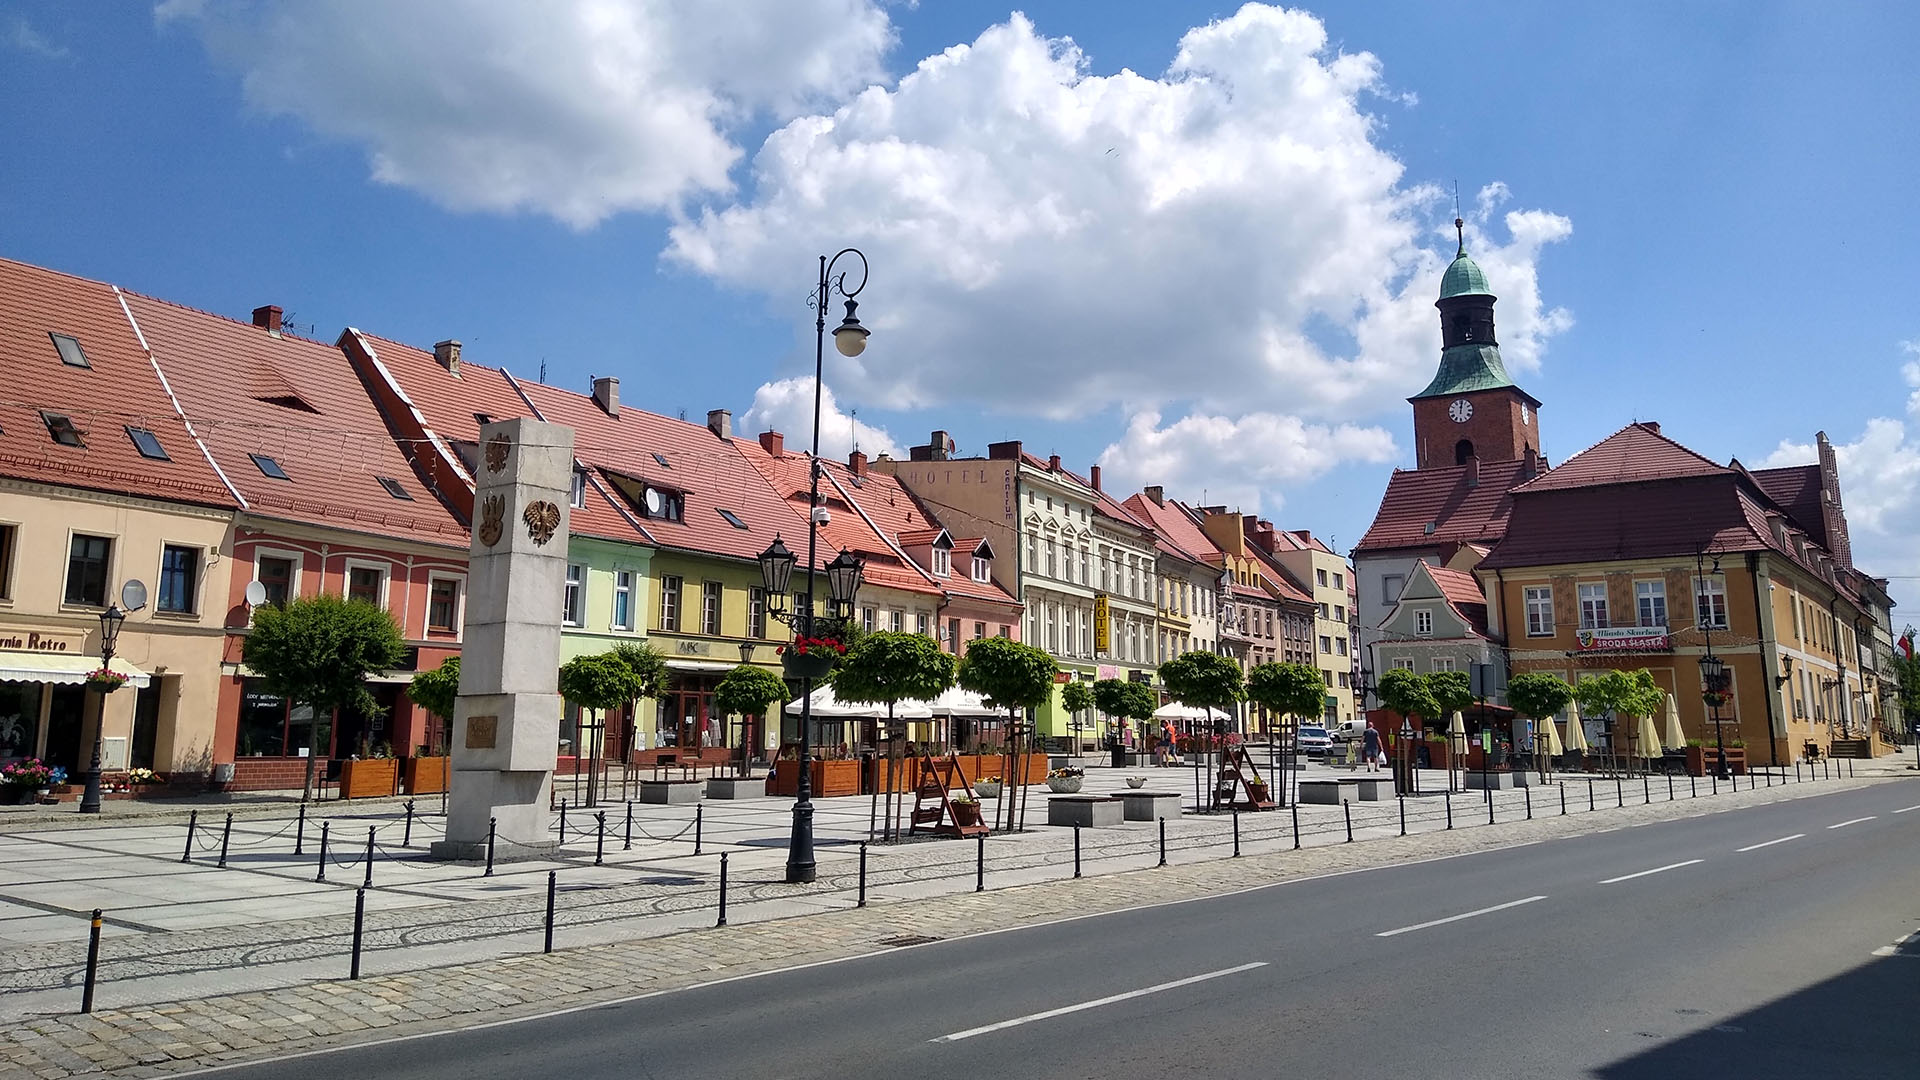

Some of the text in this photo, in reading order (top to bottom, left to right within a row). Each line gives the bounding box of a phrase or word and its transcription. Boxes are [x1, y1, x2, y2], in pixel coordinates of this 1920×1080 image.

[910, 470, 988, 484] HOTEL
[1004, 469, 1013, 520] centrum
[1097, 599, 1106, 647] HOTEL
[27, 632, 67, 651] Retro
[680, 641, 699, 653] ABC
